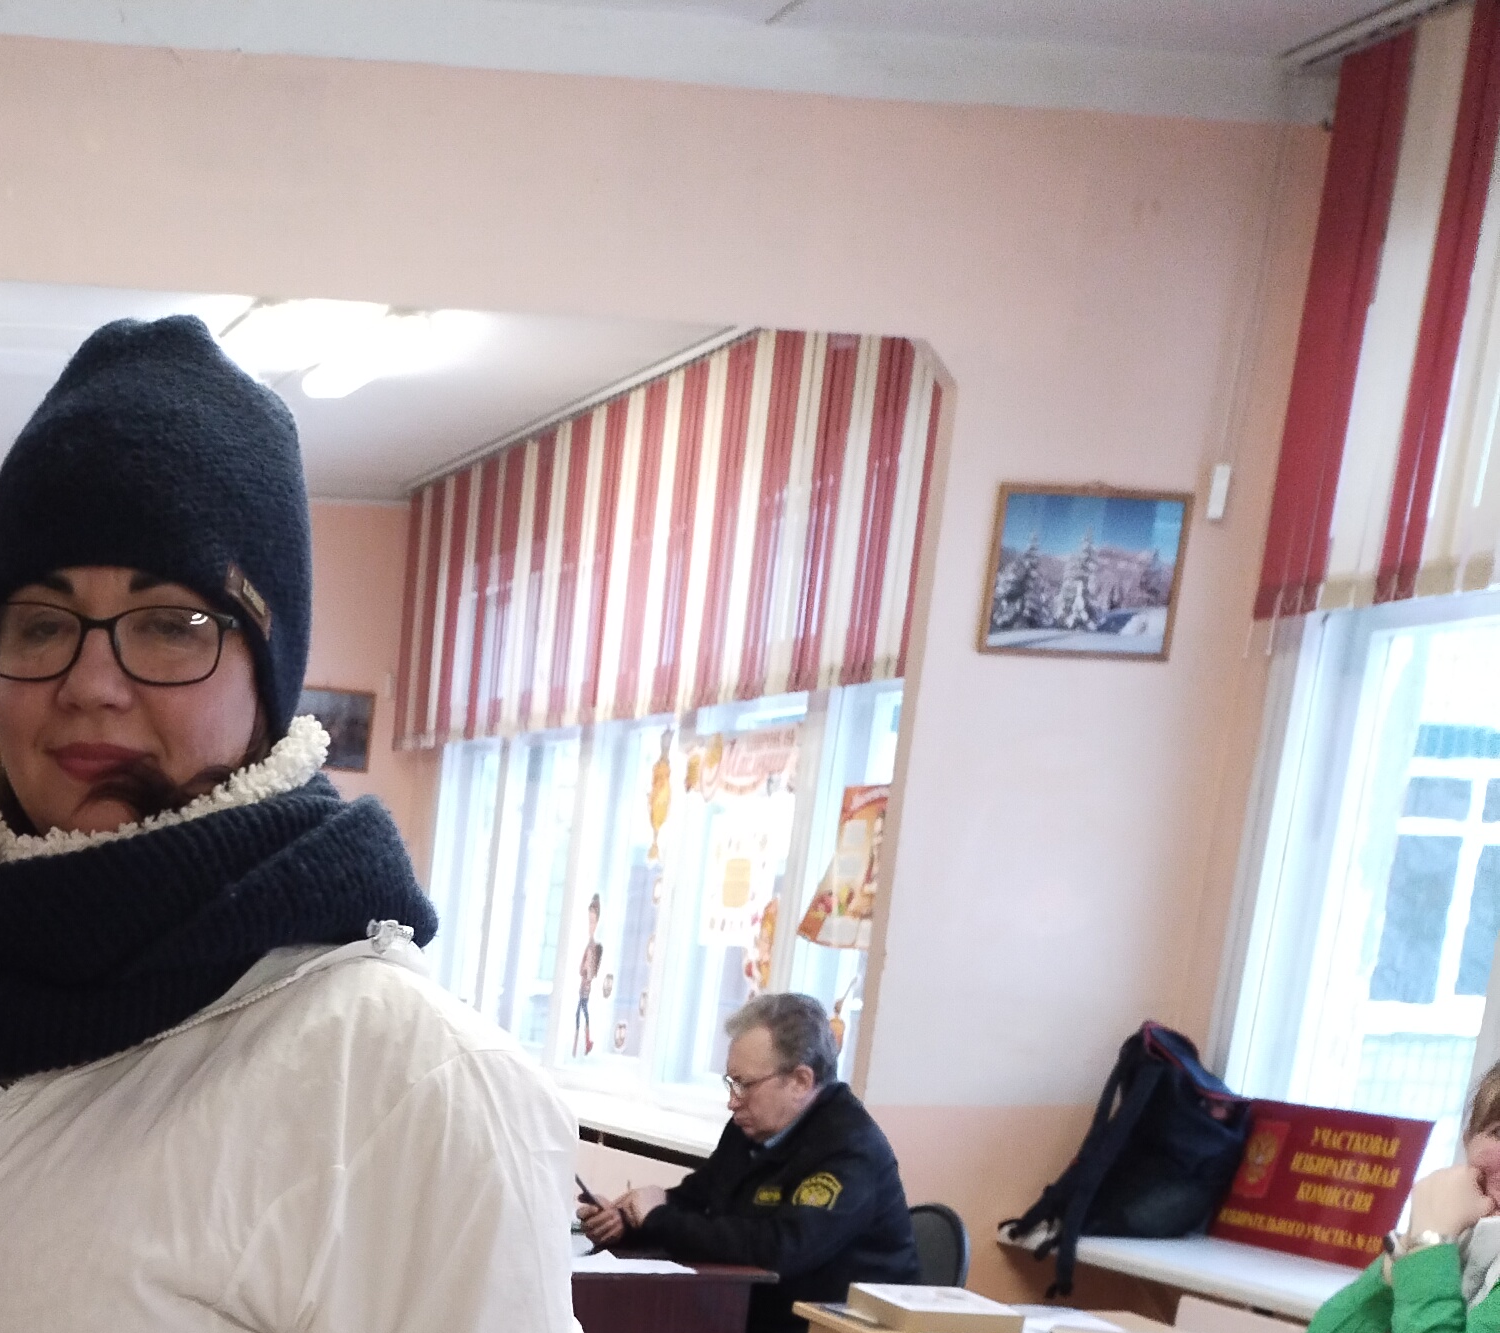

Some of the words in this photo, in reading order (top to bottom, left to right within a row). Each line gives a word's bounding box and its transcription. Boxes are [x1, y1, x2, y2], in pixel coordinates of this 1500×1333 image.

[1311, 1126, 1400, 1158] УЧАСТКОВАЯ
[1291, 1152, 1400, 1188] ИЗБИРАТЕЛЬНАЯ
[1296, 1181, 1374, 1213] КОМИССИЯ
